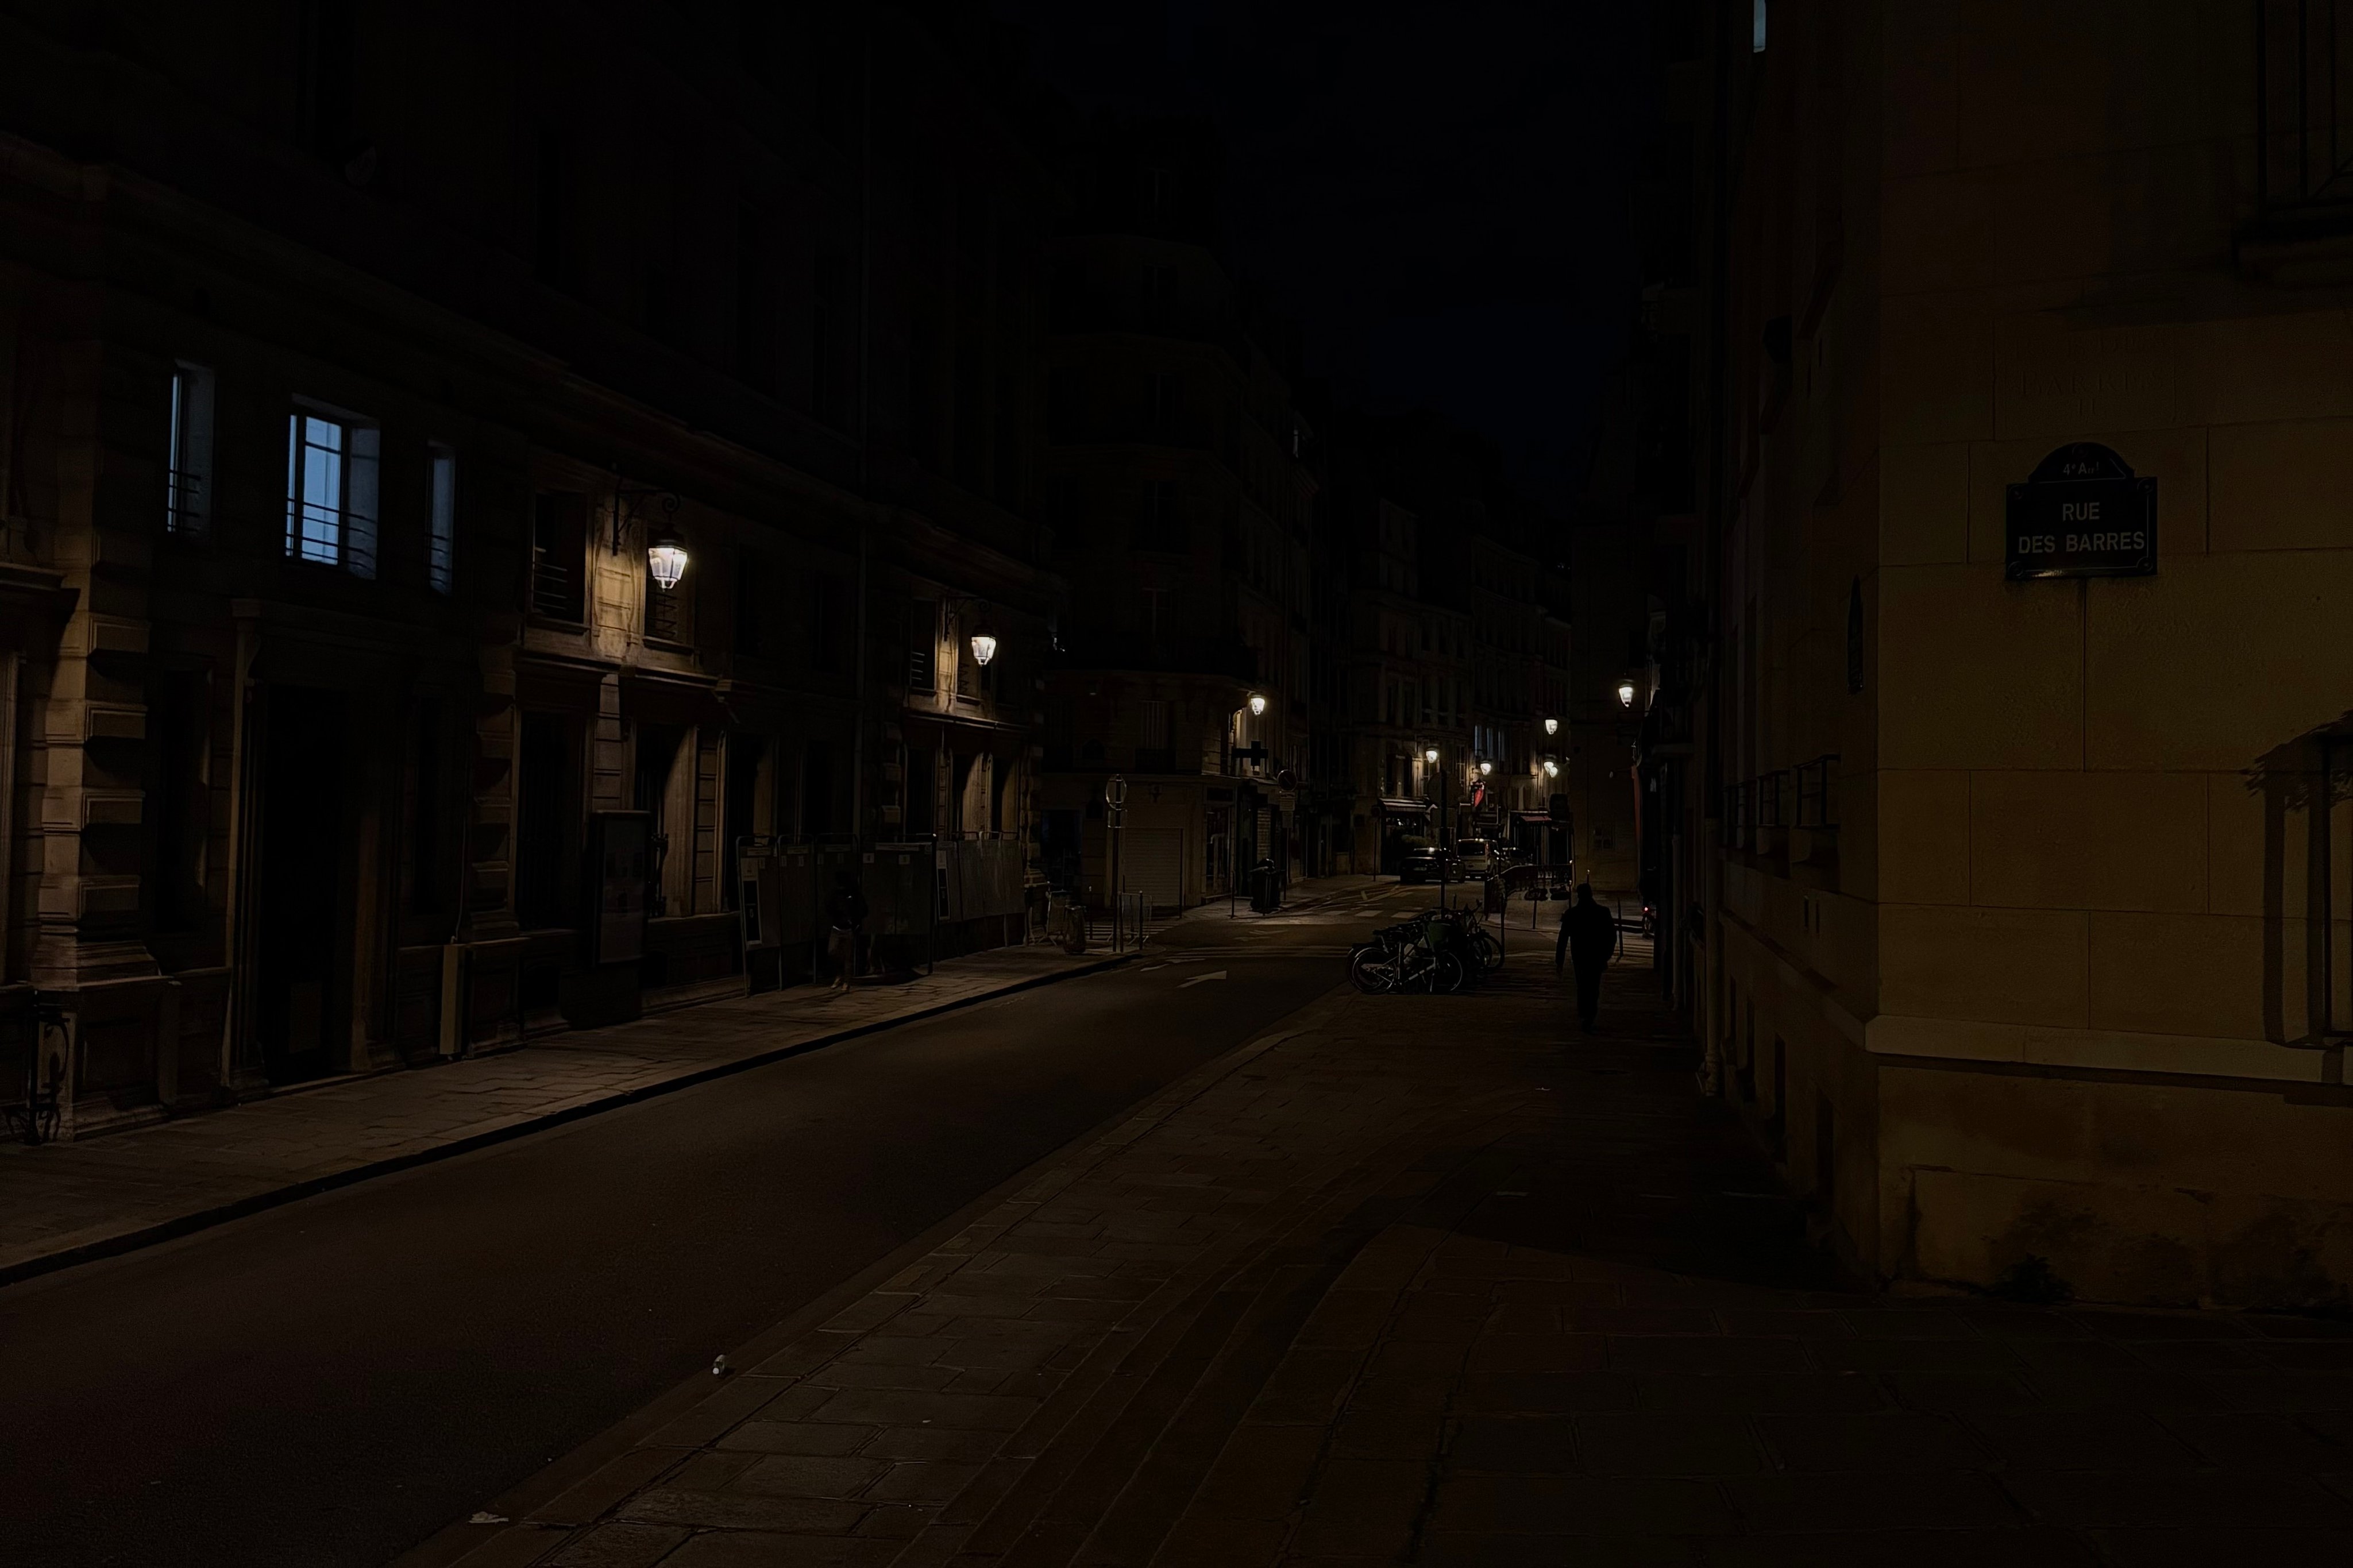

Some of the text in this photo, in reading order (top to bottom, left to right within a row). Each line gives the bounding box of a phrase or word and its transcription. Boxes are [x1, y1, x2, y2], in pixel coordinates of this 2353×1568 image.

[2062, 502, 2100, 522] RUE
[2018, 531, 2145, 554] DES BARRES
